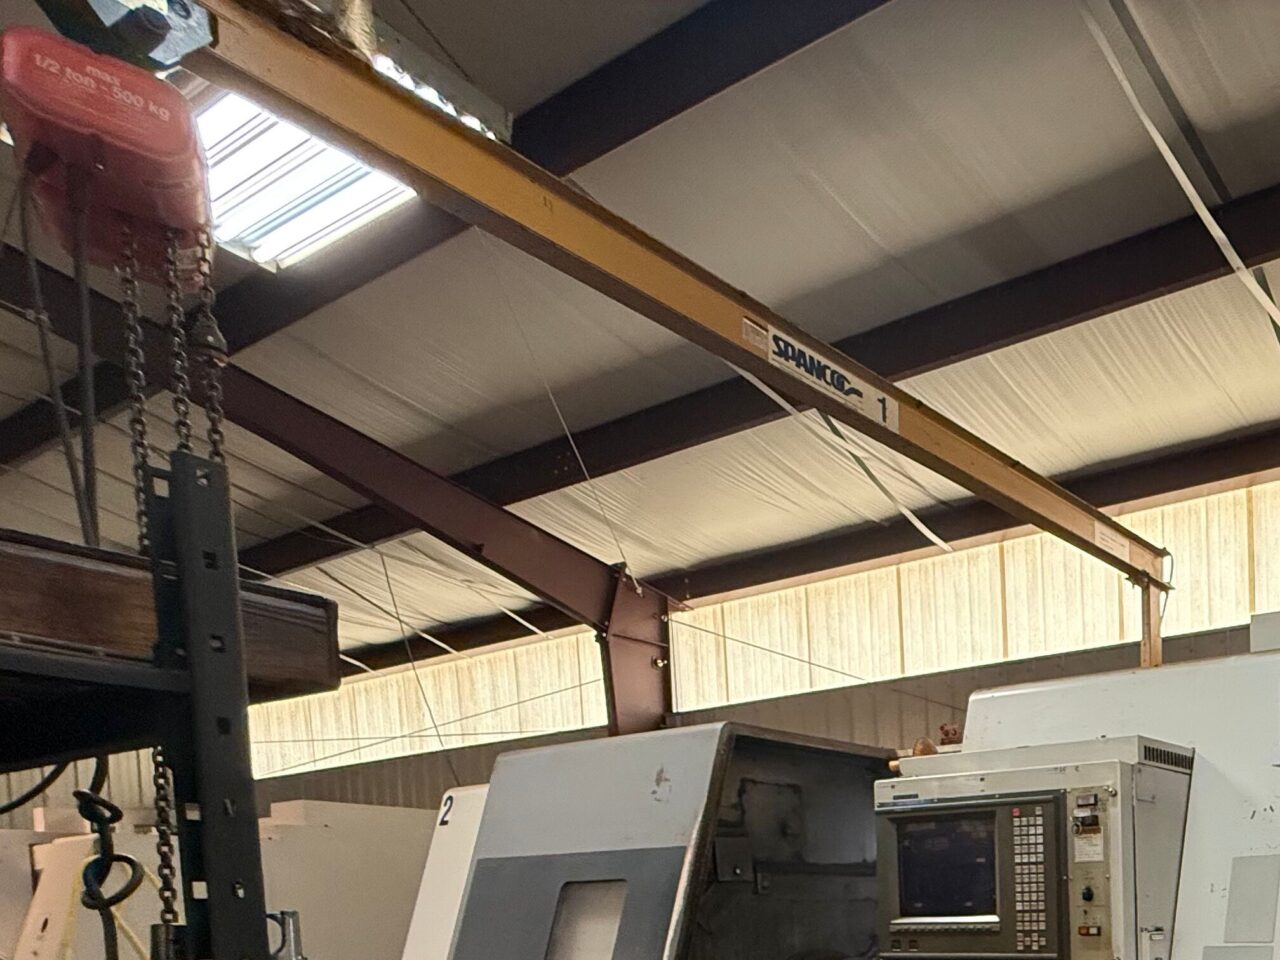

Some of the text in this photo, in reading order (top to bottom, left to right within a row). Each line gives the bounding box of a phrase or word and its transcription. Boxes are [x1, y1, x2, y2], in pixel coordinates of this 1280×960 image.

[85, 65, 121, 86] max
[64, 66, 97, 89] ton
[112, 86, 145, 108] 500
[148, 100, 170, 122] kg
[772, 334, 855, 396] SPANCO
[877, 396, 887, 423] 1
[439, 796, 454, 826] 2
